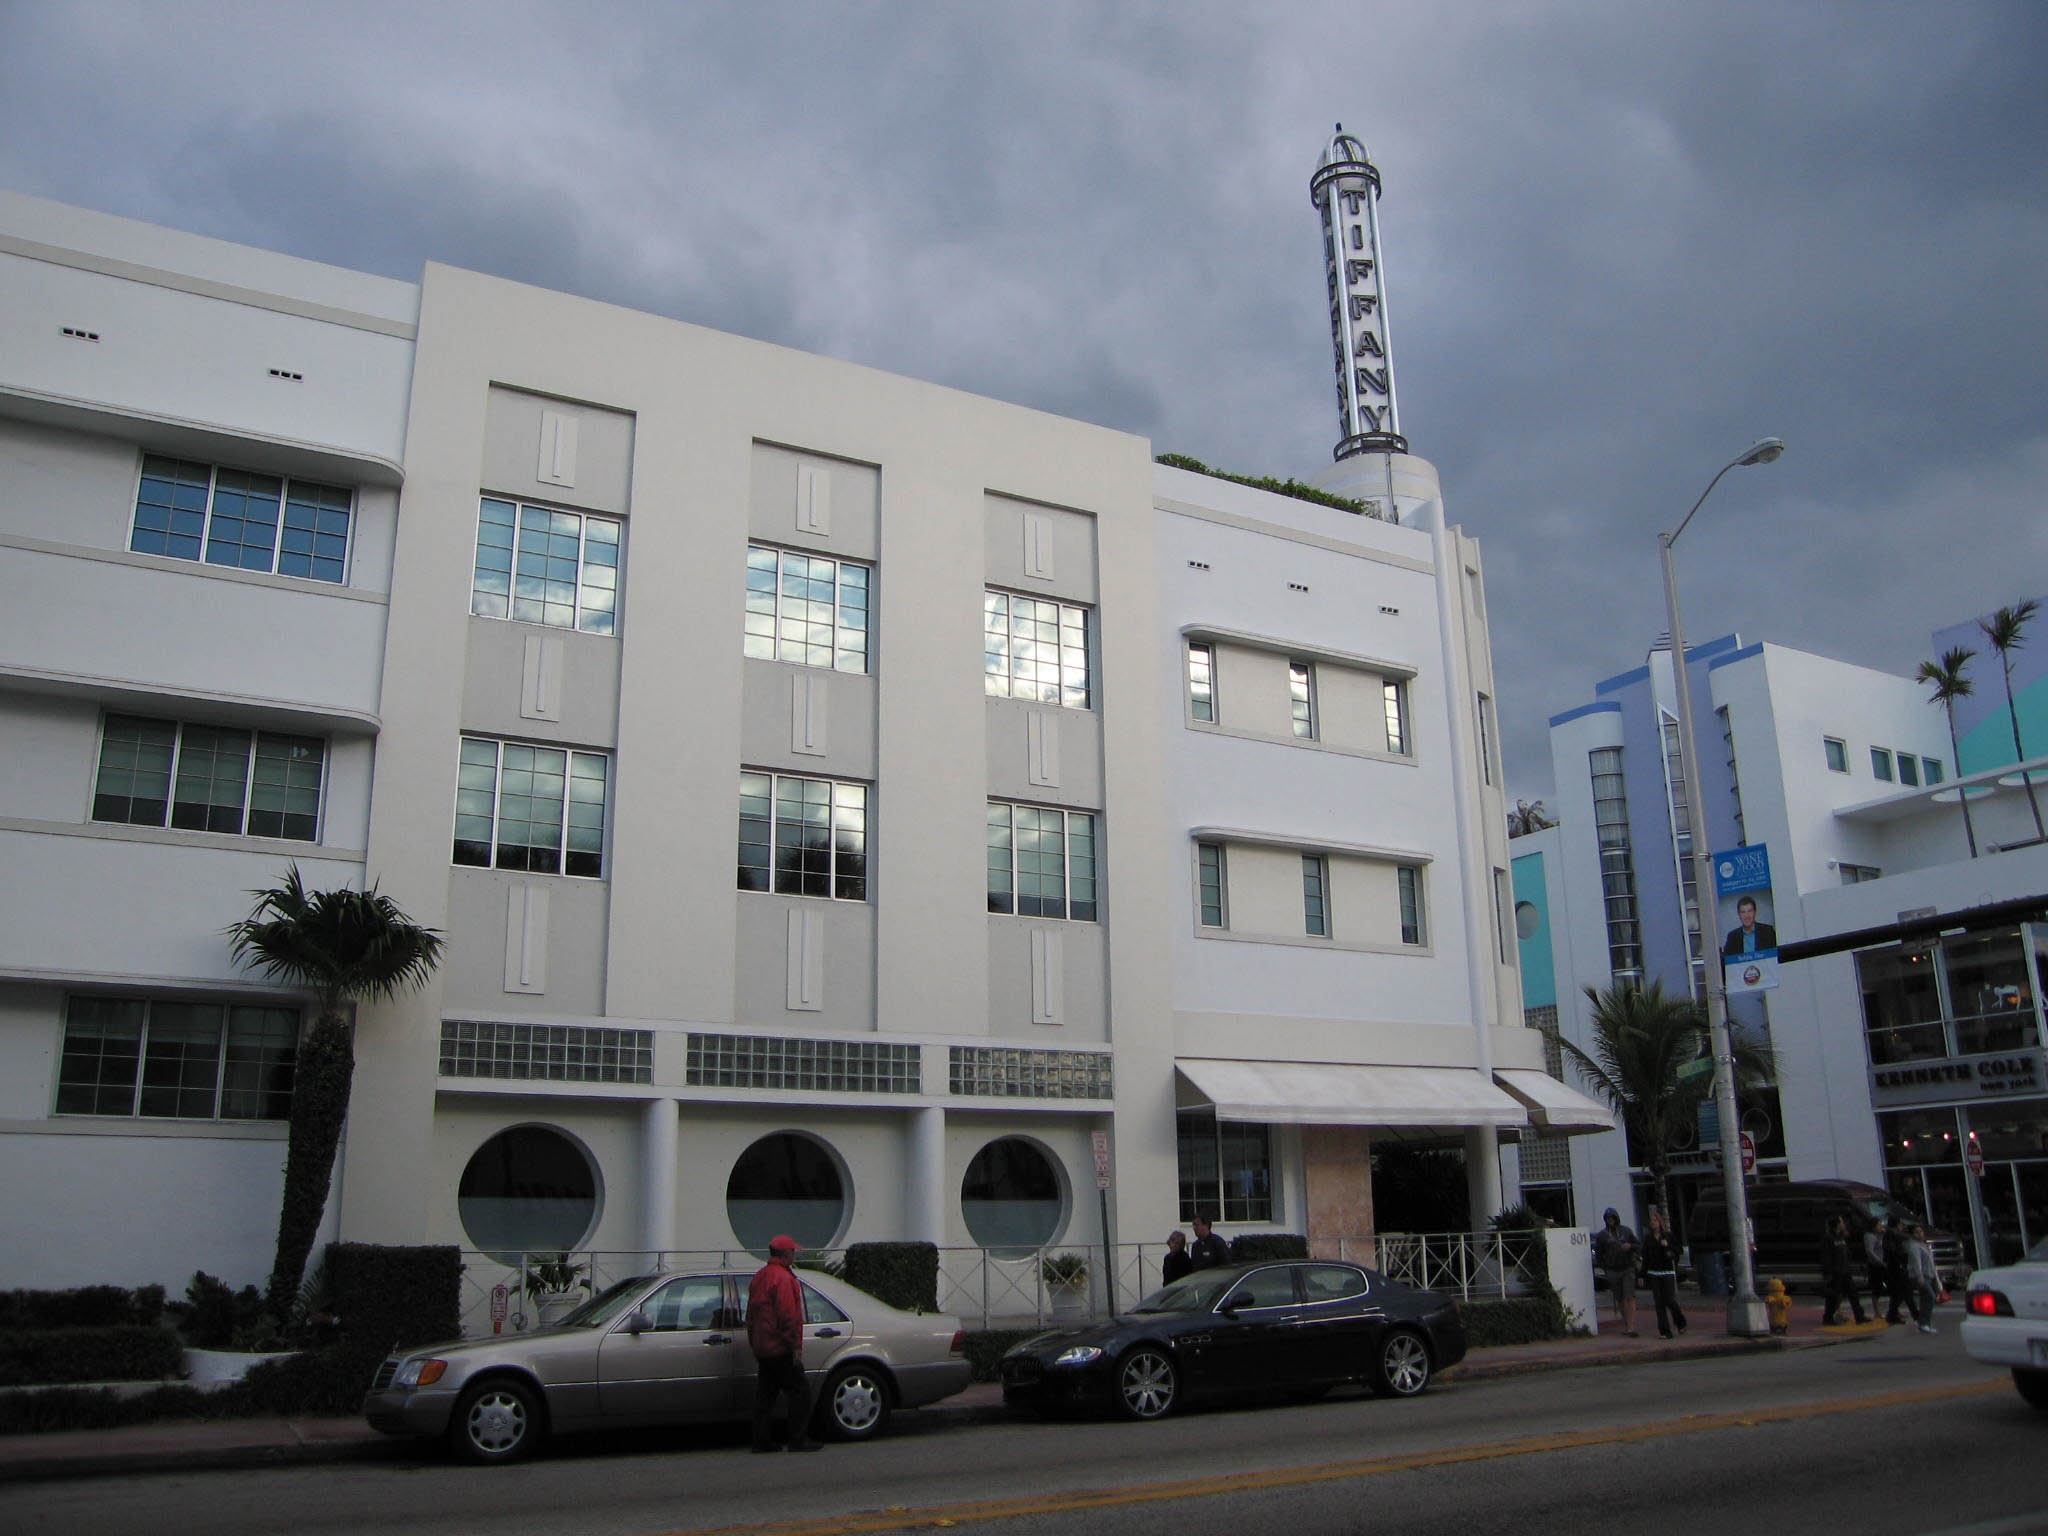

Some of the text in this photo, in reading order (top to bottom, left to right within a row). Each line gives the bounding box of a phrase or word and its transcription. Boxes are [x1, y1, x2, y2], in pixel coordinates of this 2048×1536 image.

[1341, 188, 1389, 433] TIFFANY
[1876, 1057, 2033, 1087] KENNETH COLE
[1570, 1233, 1587, 1246] 801
